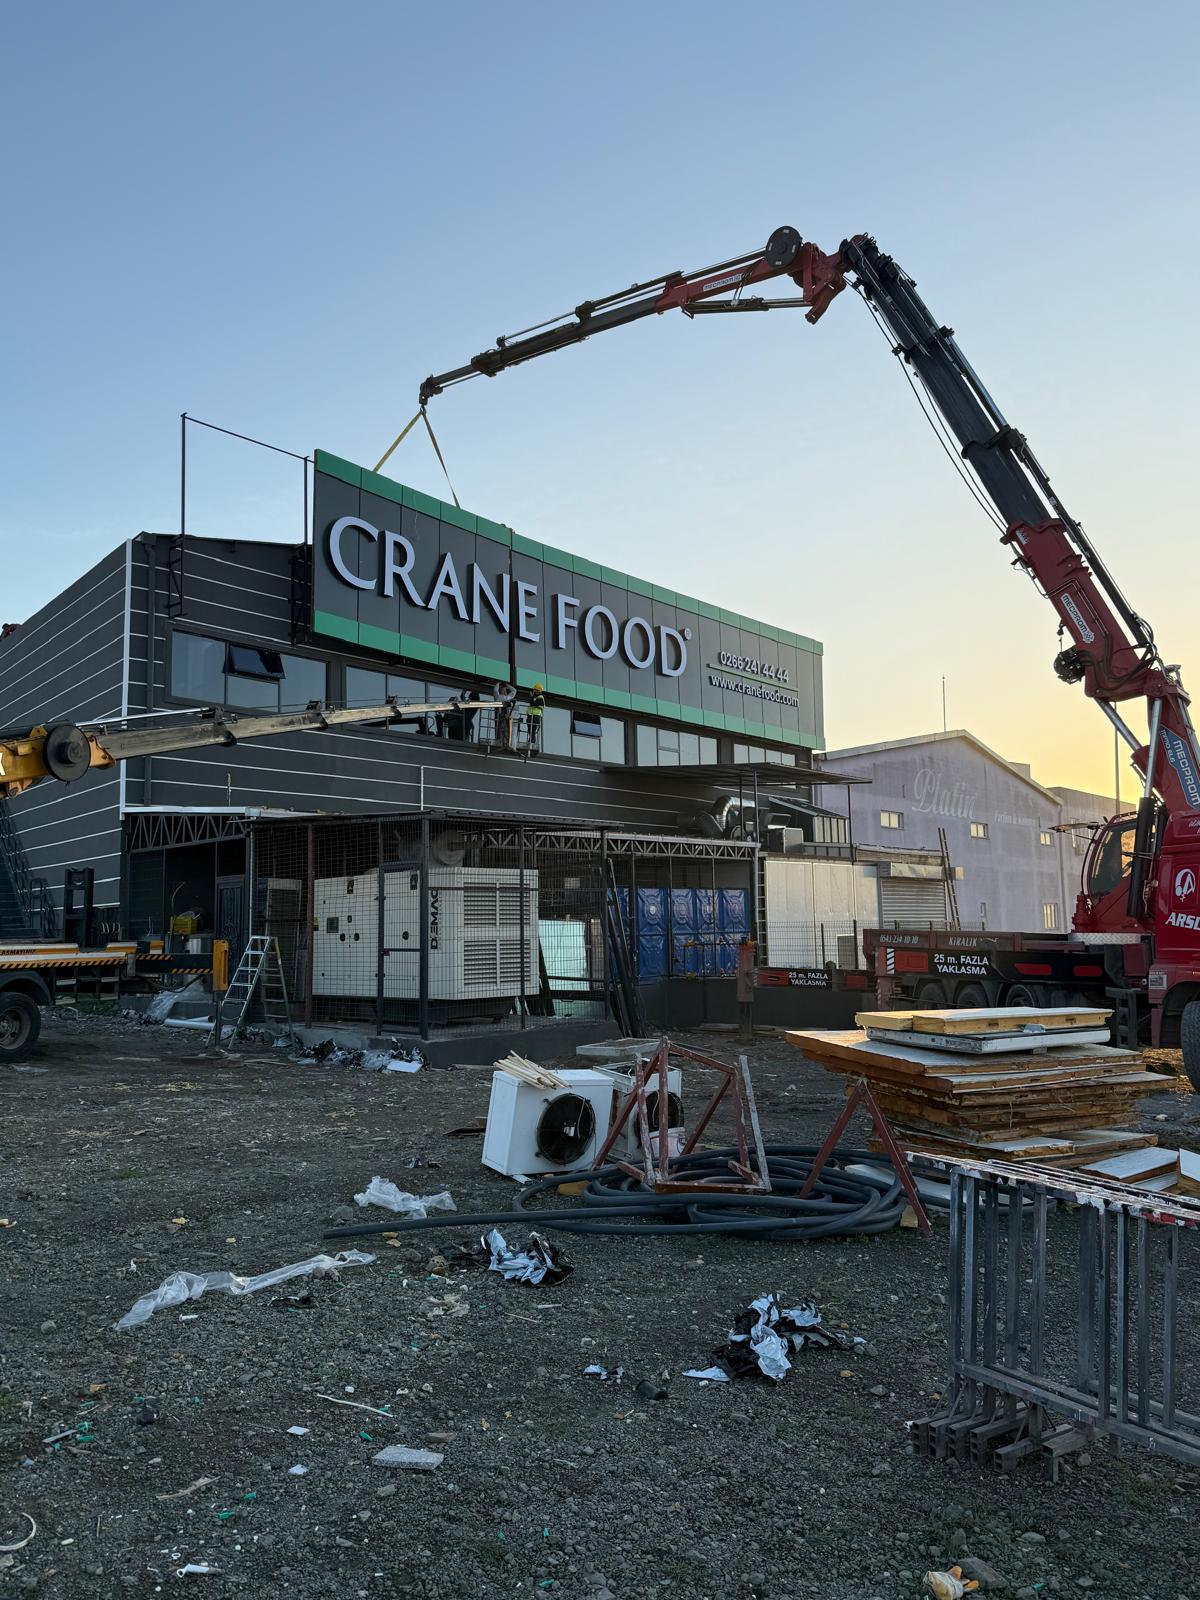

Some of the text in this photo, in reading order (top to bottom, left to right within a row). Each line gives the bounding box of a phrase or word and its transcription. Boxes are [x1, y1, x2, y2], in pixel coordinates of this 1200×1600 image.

[328, 515, 540, 643] CRANE
[1062, 594, 1088, 634] MECPROM
[719, 651, 790, 683] 0266 241 44 44
[711, 674, 799, 707] www.cranefood.com
[1173, 740, 1200, 806] MECPROM
[933, 953, 945, 963] 25
[960, 955, 990, 966] FAZLA
[937, 964, 987, 975] YAKLASMA
[807, 972, 829, 980] FAZLA
